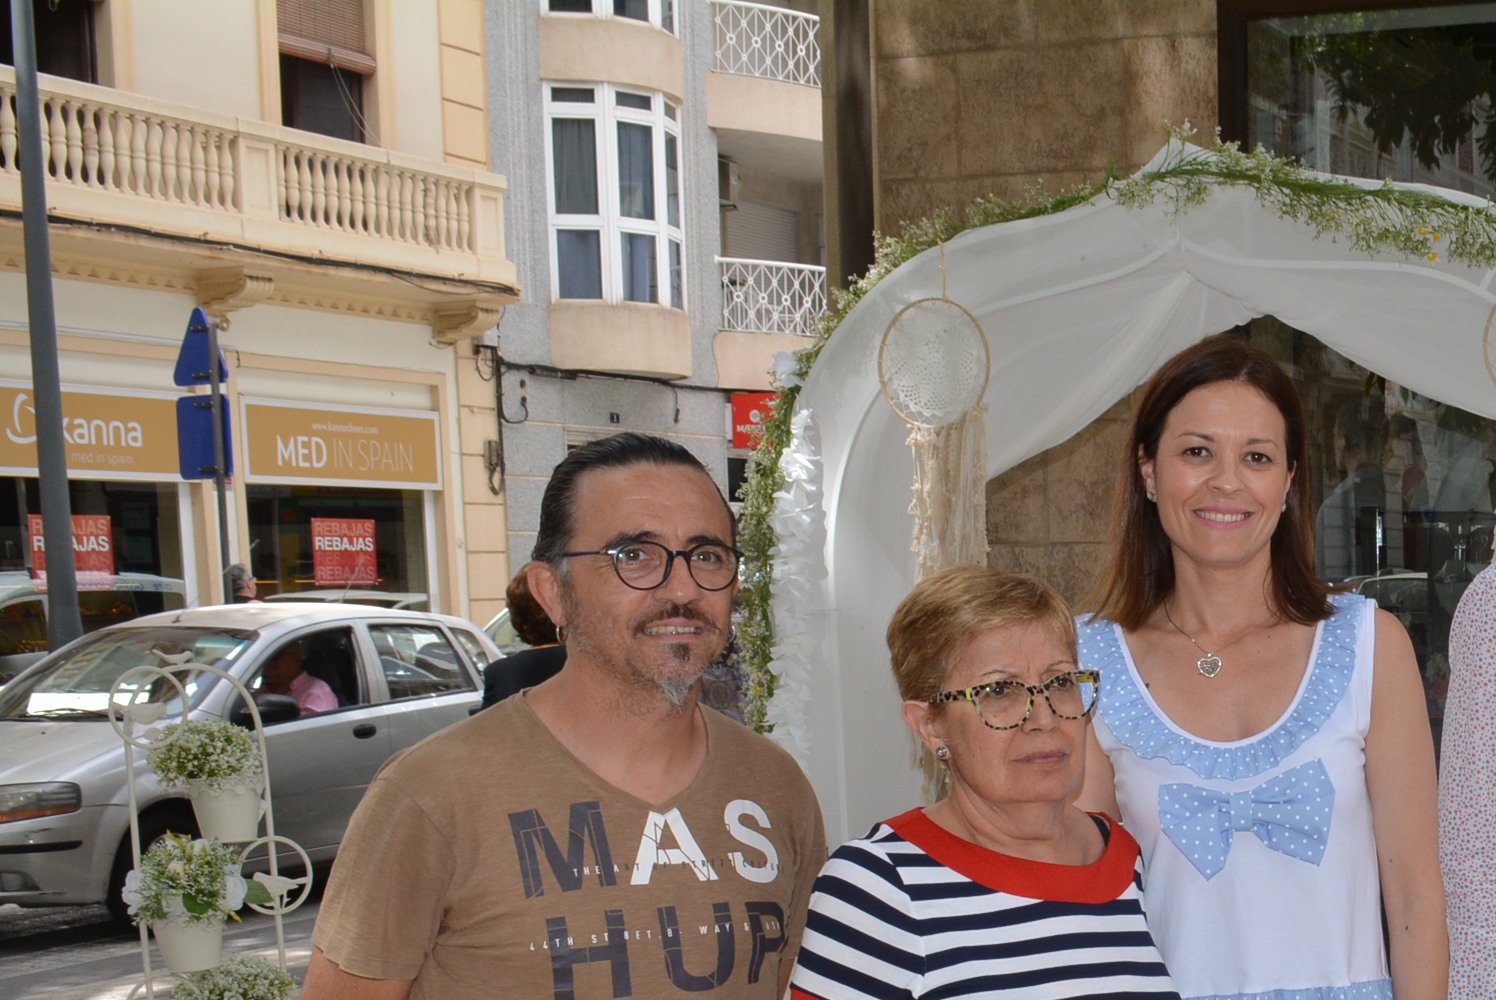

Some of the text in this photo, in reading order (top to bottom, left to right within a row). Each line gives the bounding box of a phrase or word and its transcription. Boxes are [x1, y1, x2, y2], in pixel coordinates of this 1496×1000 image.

[71, 451, 133, 465] med in spain
[276, 434, 414, 472] MED IN SPAIN
[32, 518, 108, 535] RAJAS
[315, 522, 372, 537] REBAJAS
[33, 535, 110, 552] RAJAS
[315, 536, 374, 552] REBAJAS
[573, 865, 601, 877] THE
[529, 937, 574, 951] 44TH
